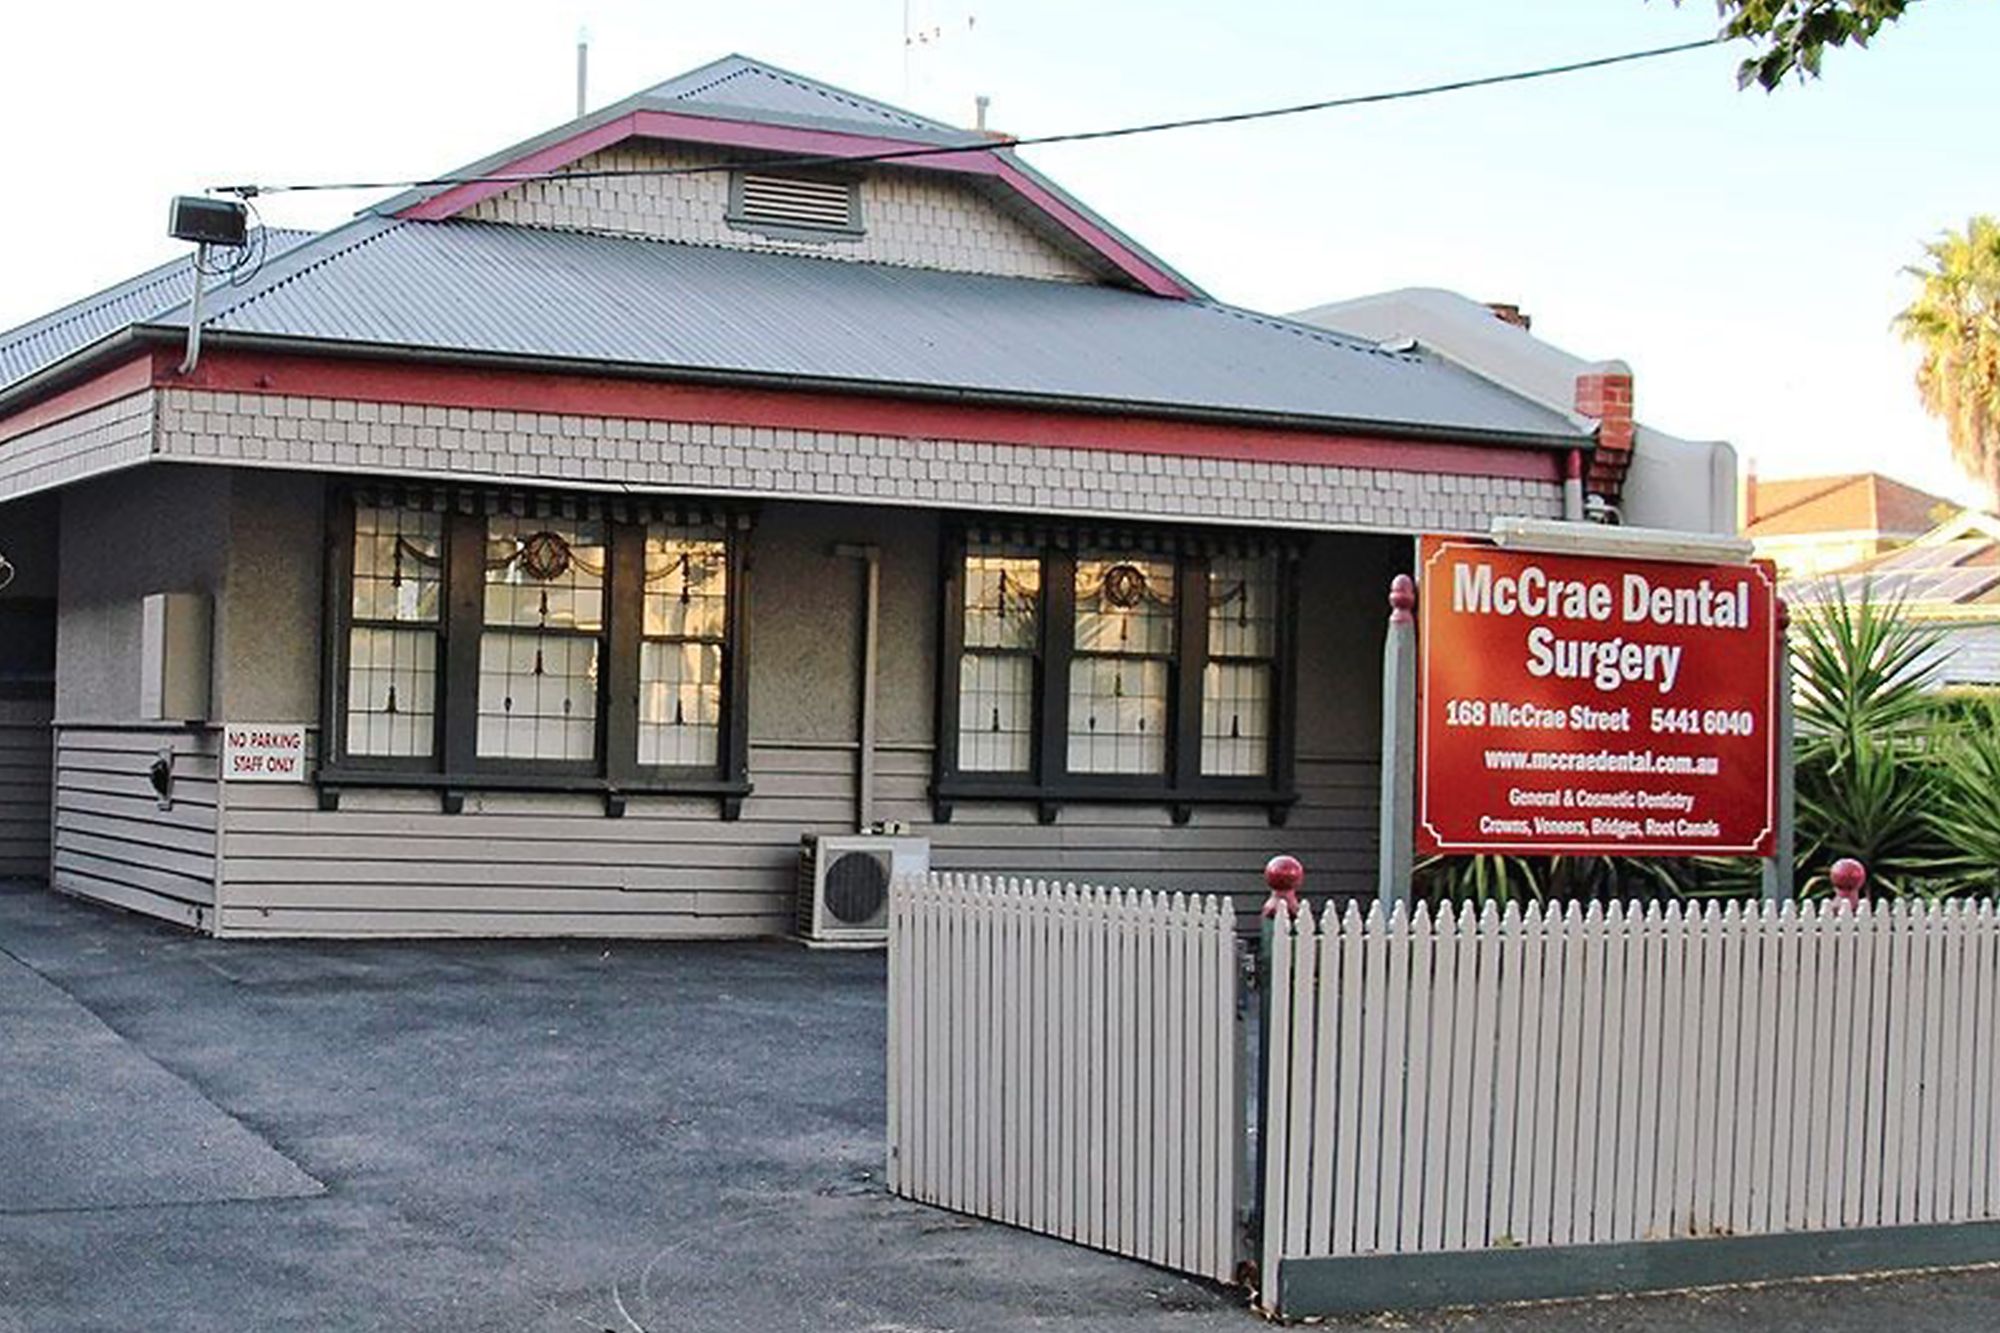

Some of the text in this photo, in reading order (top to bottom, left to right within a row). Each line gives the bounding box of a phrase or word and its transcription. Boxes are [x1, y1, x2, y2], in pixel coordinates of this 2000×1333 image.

[1453, 563, 1749, 628] McCrae Dental
[1526, 626, 1682, 693] Surgery
[1446, 700, 1754, 736] 168 McCrae Street 5441 6040
[228, 732, 301, 749] NO PARKING
[234, 755, 295, 772] STAFF ONLY
[1484, 749, 1719, 775] www.mccraedental.com.au
[1509, 788, 1695, 813] General & Cosmetic Dentistry
[1480, 816, 1720, 839] Crowns, Veneers, Bridges, Root Canals
